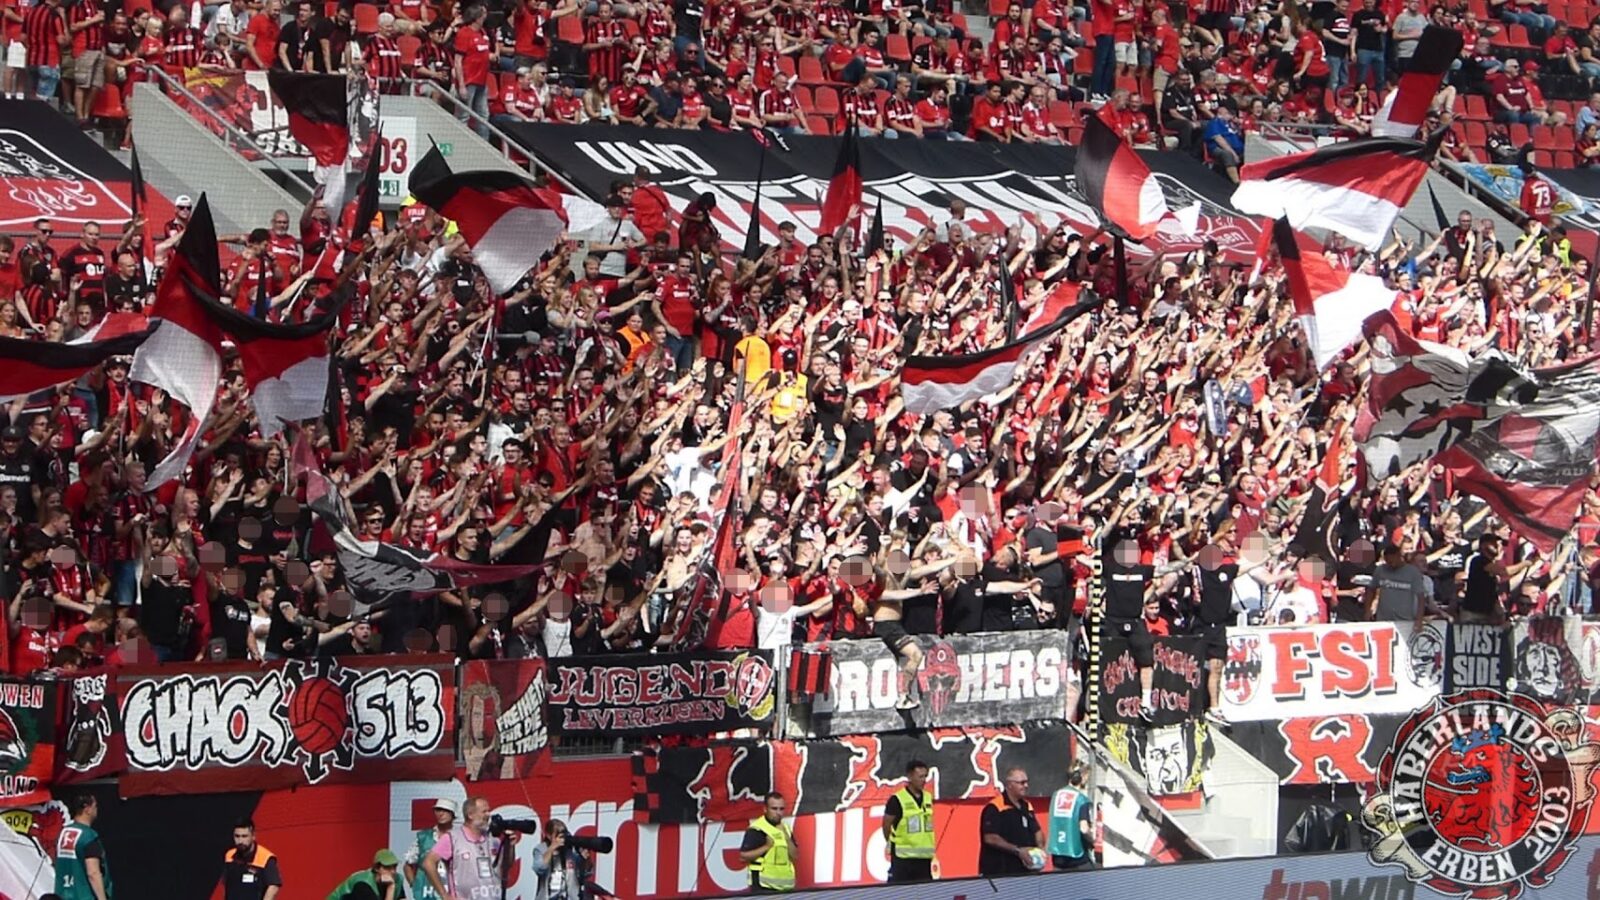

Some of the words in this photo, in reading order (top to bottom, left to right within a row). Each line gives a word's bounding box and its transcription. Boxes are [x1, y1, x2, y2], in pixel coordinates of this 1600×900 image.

[575, 140, 718, 177] UND
[1452, 624, 1504, 655] WEST
[549, 660, 735, 706] JUGEND
[829, 647, 1061, 713] ROHERS
[1268, 627, 1398, 702] FSI
[1452, 654, 1502, 687] SIDE
[122, 674, 289, 771] CHAOS
[352, 668, 445, 757] 513
[563, 701, 726, 730] LEVERKUSEN
[1057, 830, 1067, 843] 2
